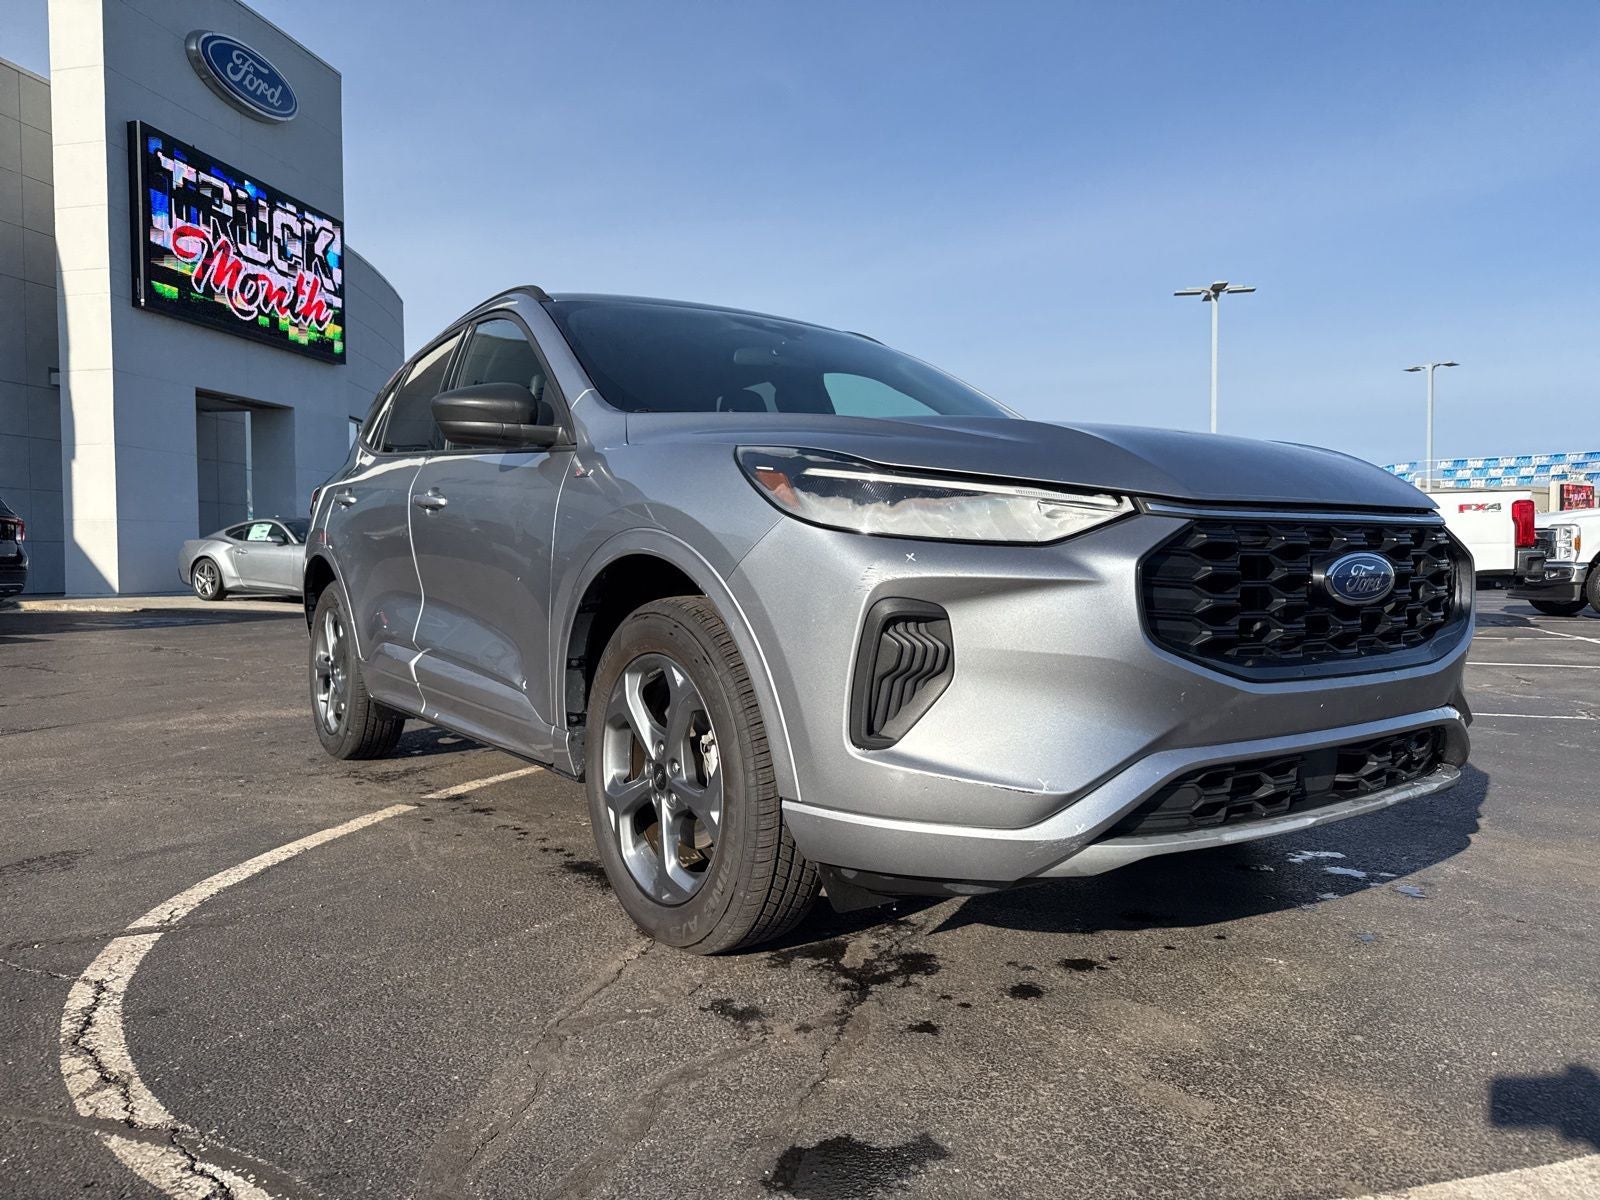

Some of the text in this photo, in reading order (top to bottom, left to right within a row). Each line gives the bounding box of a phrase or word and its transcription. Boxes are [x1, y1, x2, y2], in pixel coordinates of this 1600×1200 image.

[227, 50, 282, 107] Ford
[158, 152, 337, 290] TRUCK
[172, 224, 332, 330] Month
[1458, 503, 1502, 514] FX4
[1346, 563, 1385, 593] Ford
